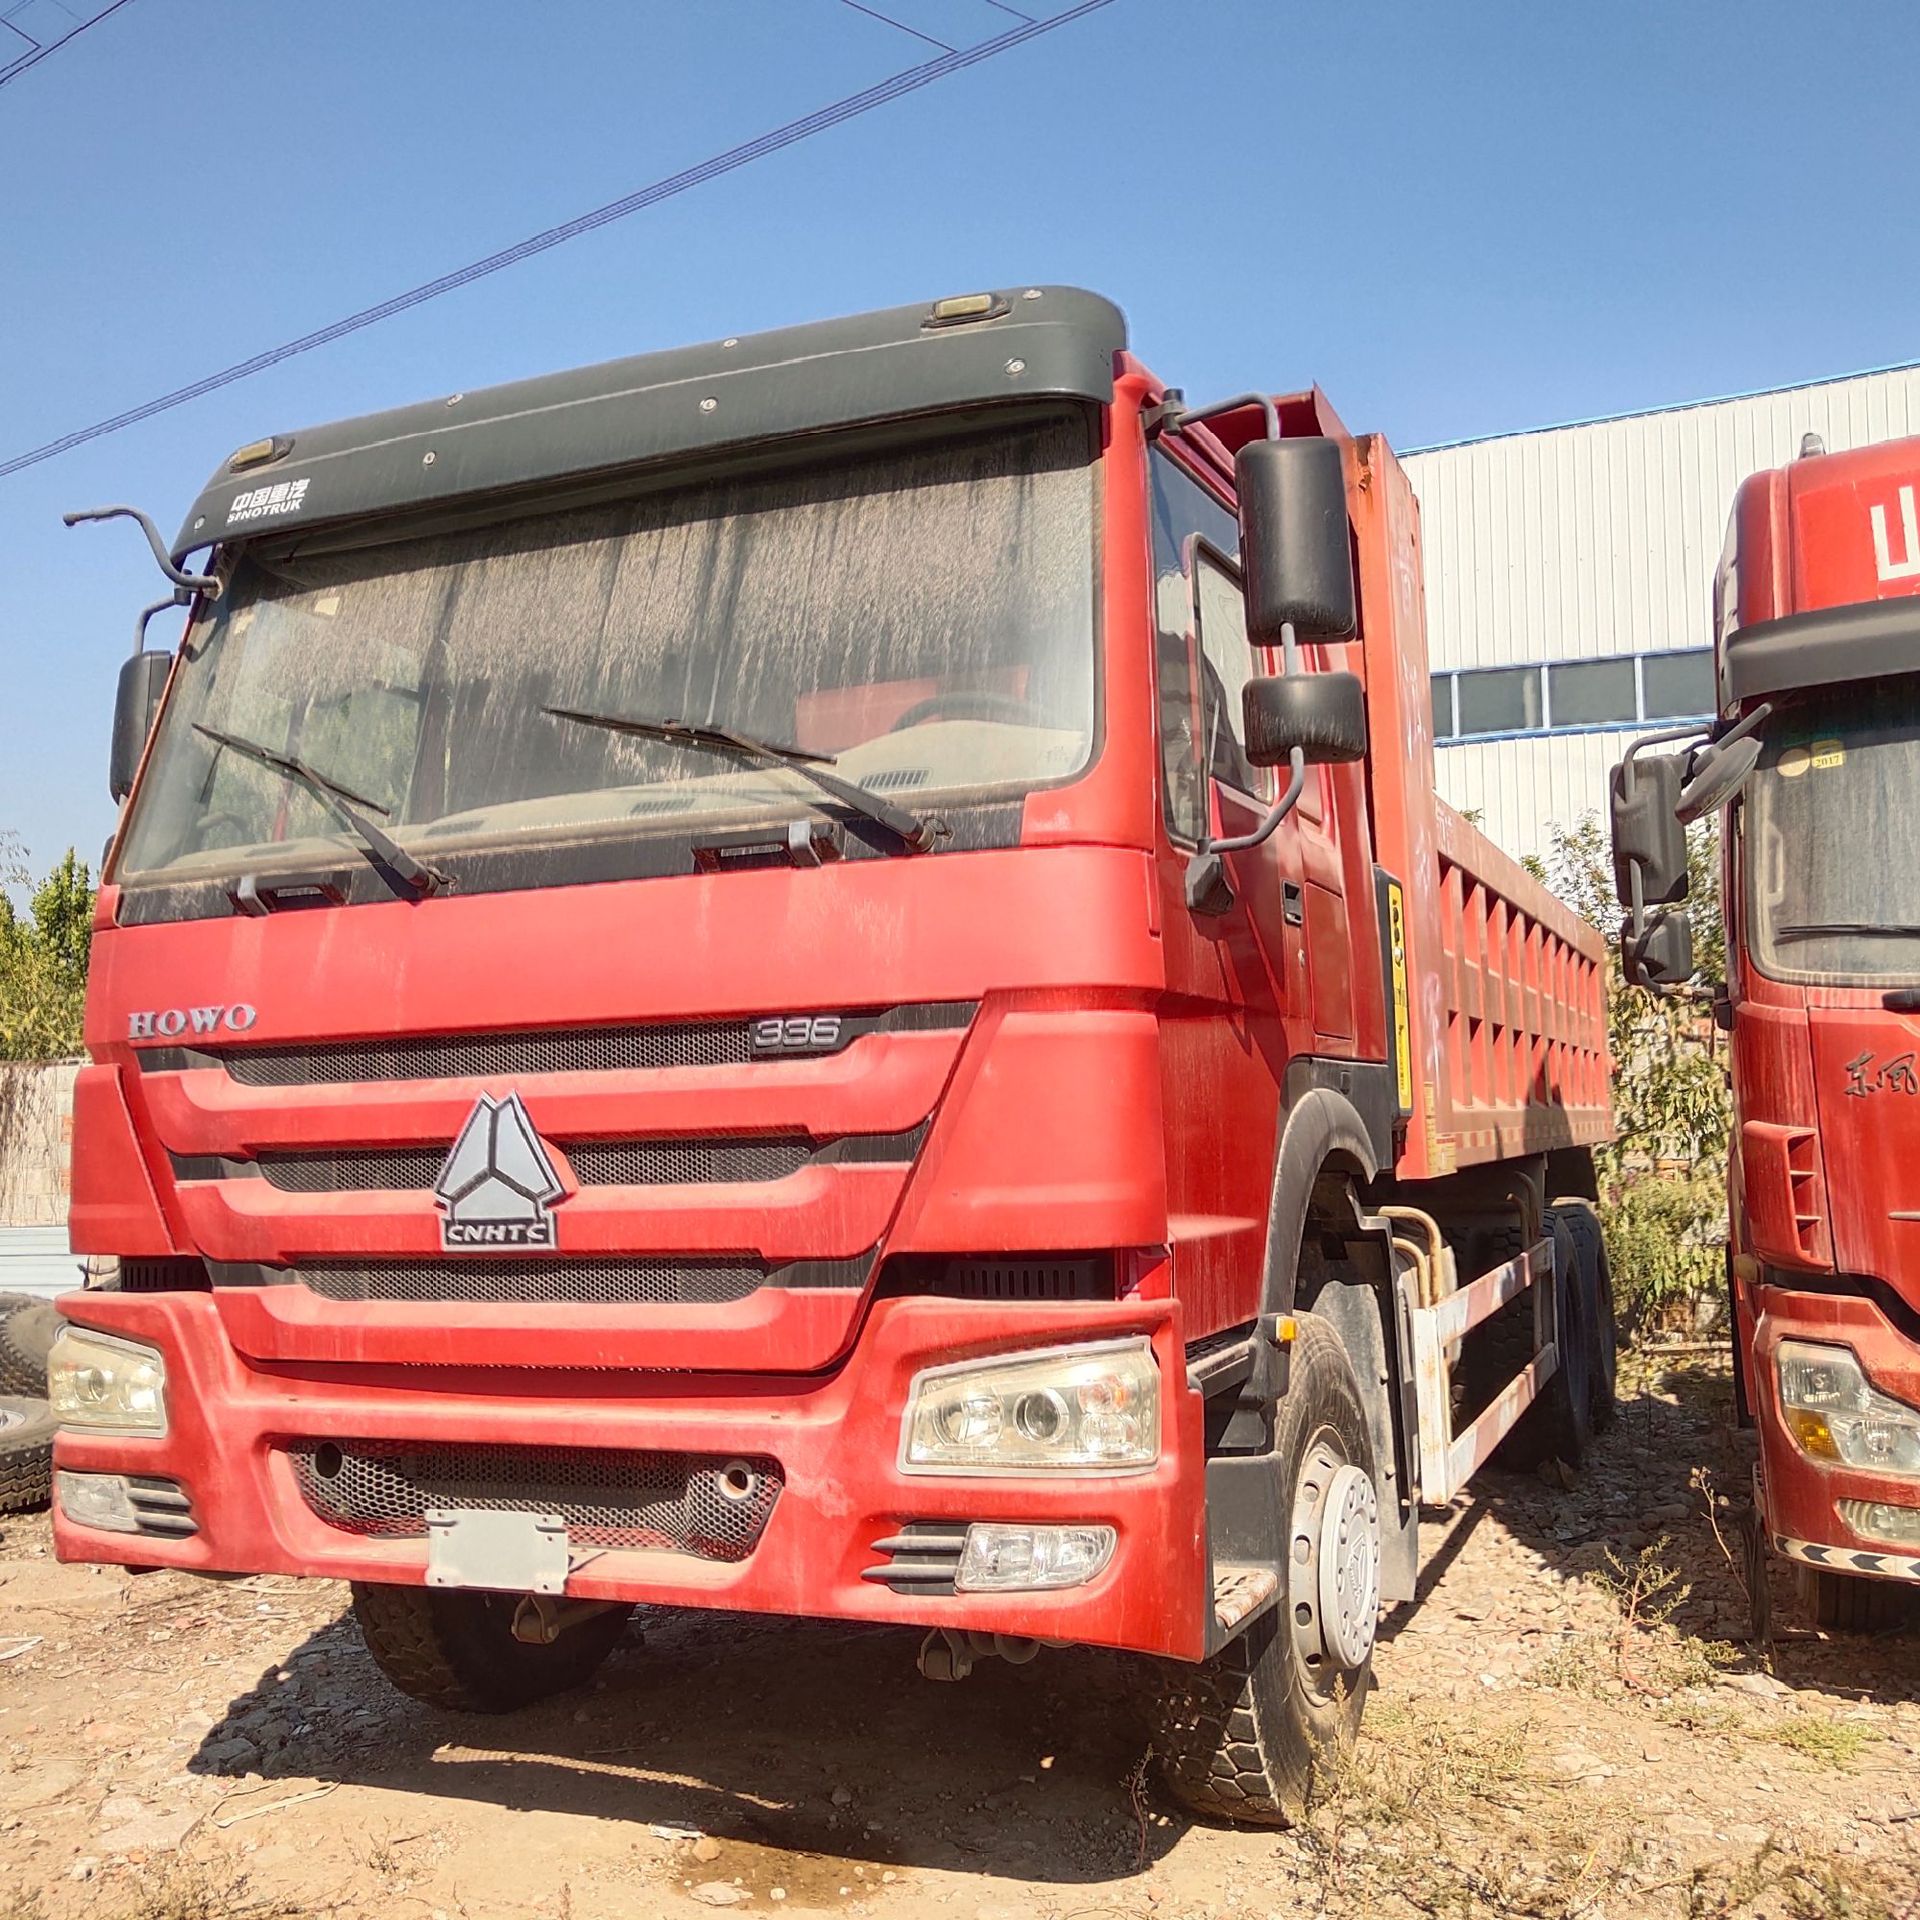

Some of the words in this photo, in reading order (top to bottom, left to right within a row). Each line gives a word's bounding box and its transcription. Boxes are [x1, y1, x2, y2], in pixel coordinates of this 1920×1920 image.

[231, 478, 311, 511] 中国重汽
[227, 499, 303, 523] SINOTRUK
[1815, 755, 1840, 768] 2017
[128, 1004, 256, 1039] HOWO
[755, 1017, 841, 1048] 336
[1844, 1050, 1918, 1099] 东风
[447, 1223, 548, 1242] CNHTC
